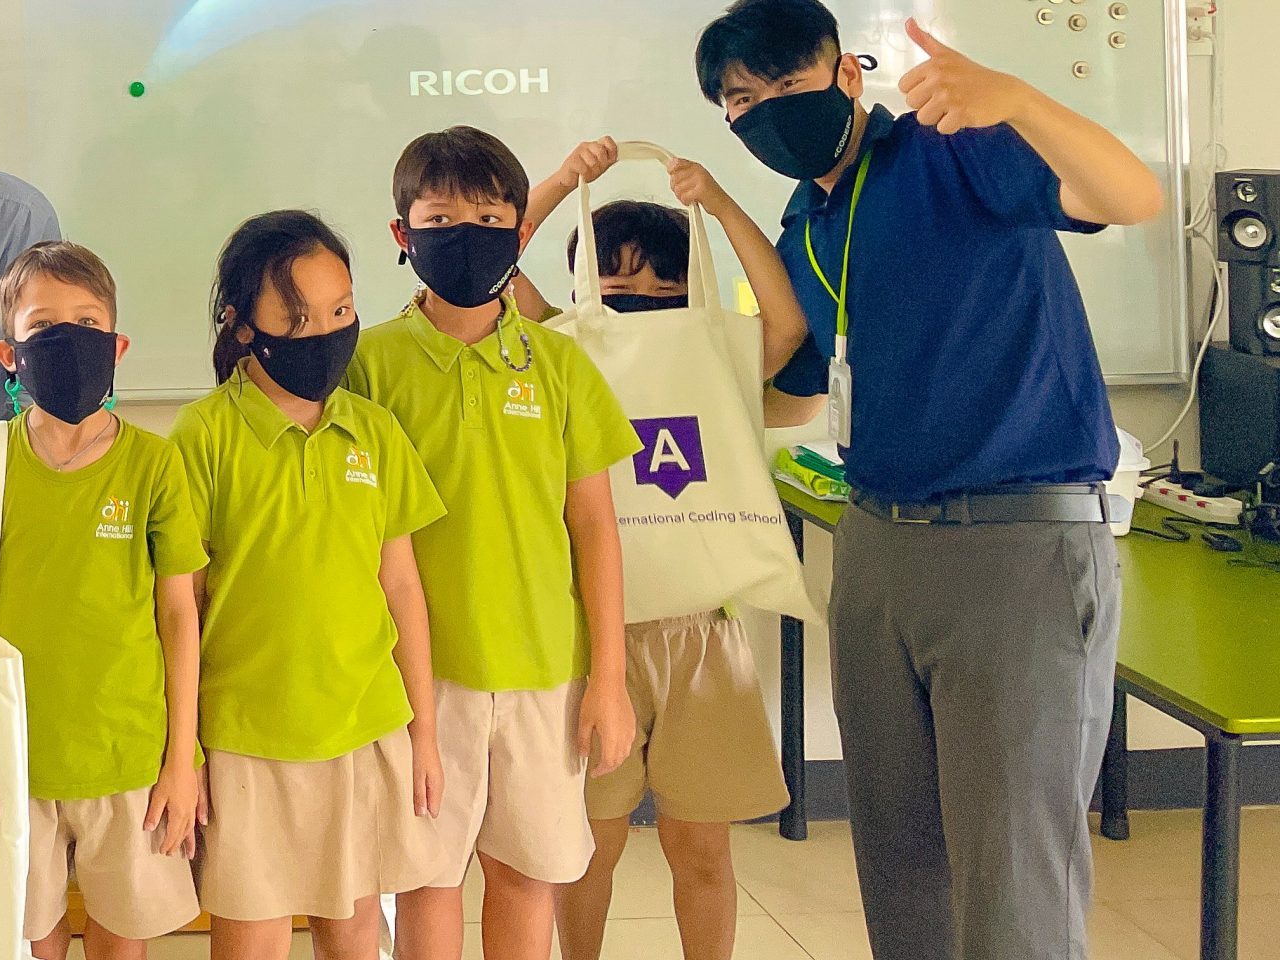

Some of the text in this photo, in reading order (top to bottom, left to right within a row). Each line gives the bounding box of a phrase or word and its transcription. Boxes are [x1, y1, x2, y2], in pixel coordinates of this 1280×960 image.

[409, 68, 549, 96] RICOH
[649, 429, 691, 473] A
[96, 523, 120, 532] Anne
[616, 510, 782, 526] ernational Coding School
